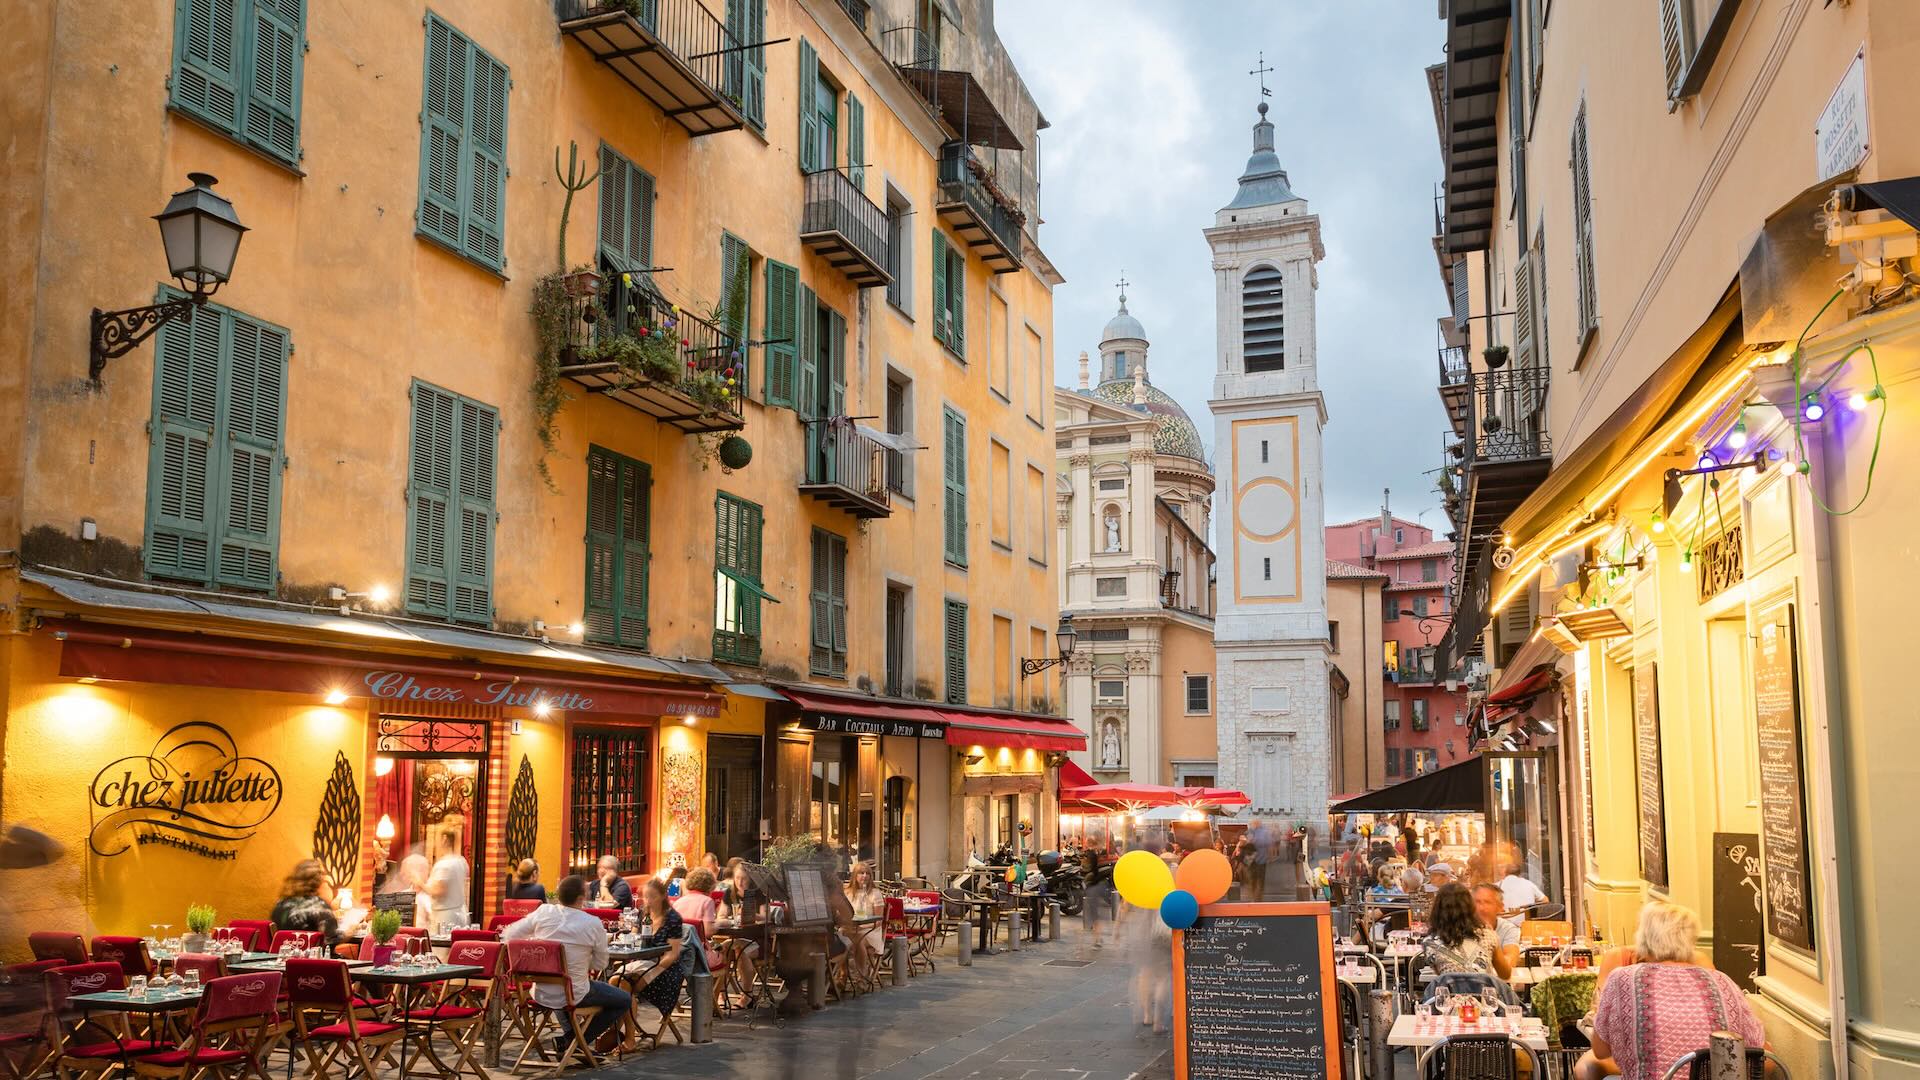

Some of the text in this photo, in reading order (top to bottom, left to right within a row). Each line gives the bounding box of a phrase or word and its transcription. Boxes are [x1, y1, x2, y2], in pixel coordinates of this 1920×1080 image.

[1831, 88, 1846, 120] RUE
[364, 670, 595, 712] Chez Juliette
[99, 769, 276, 821] chez juliette
[138, 832, 239, 862] RESTAURANT
